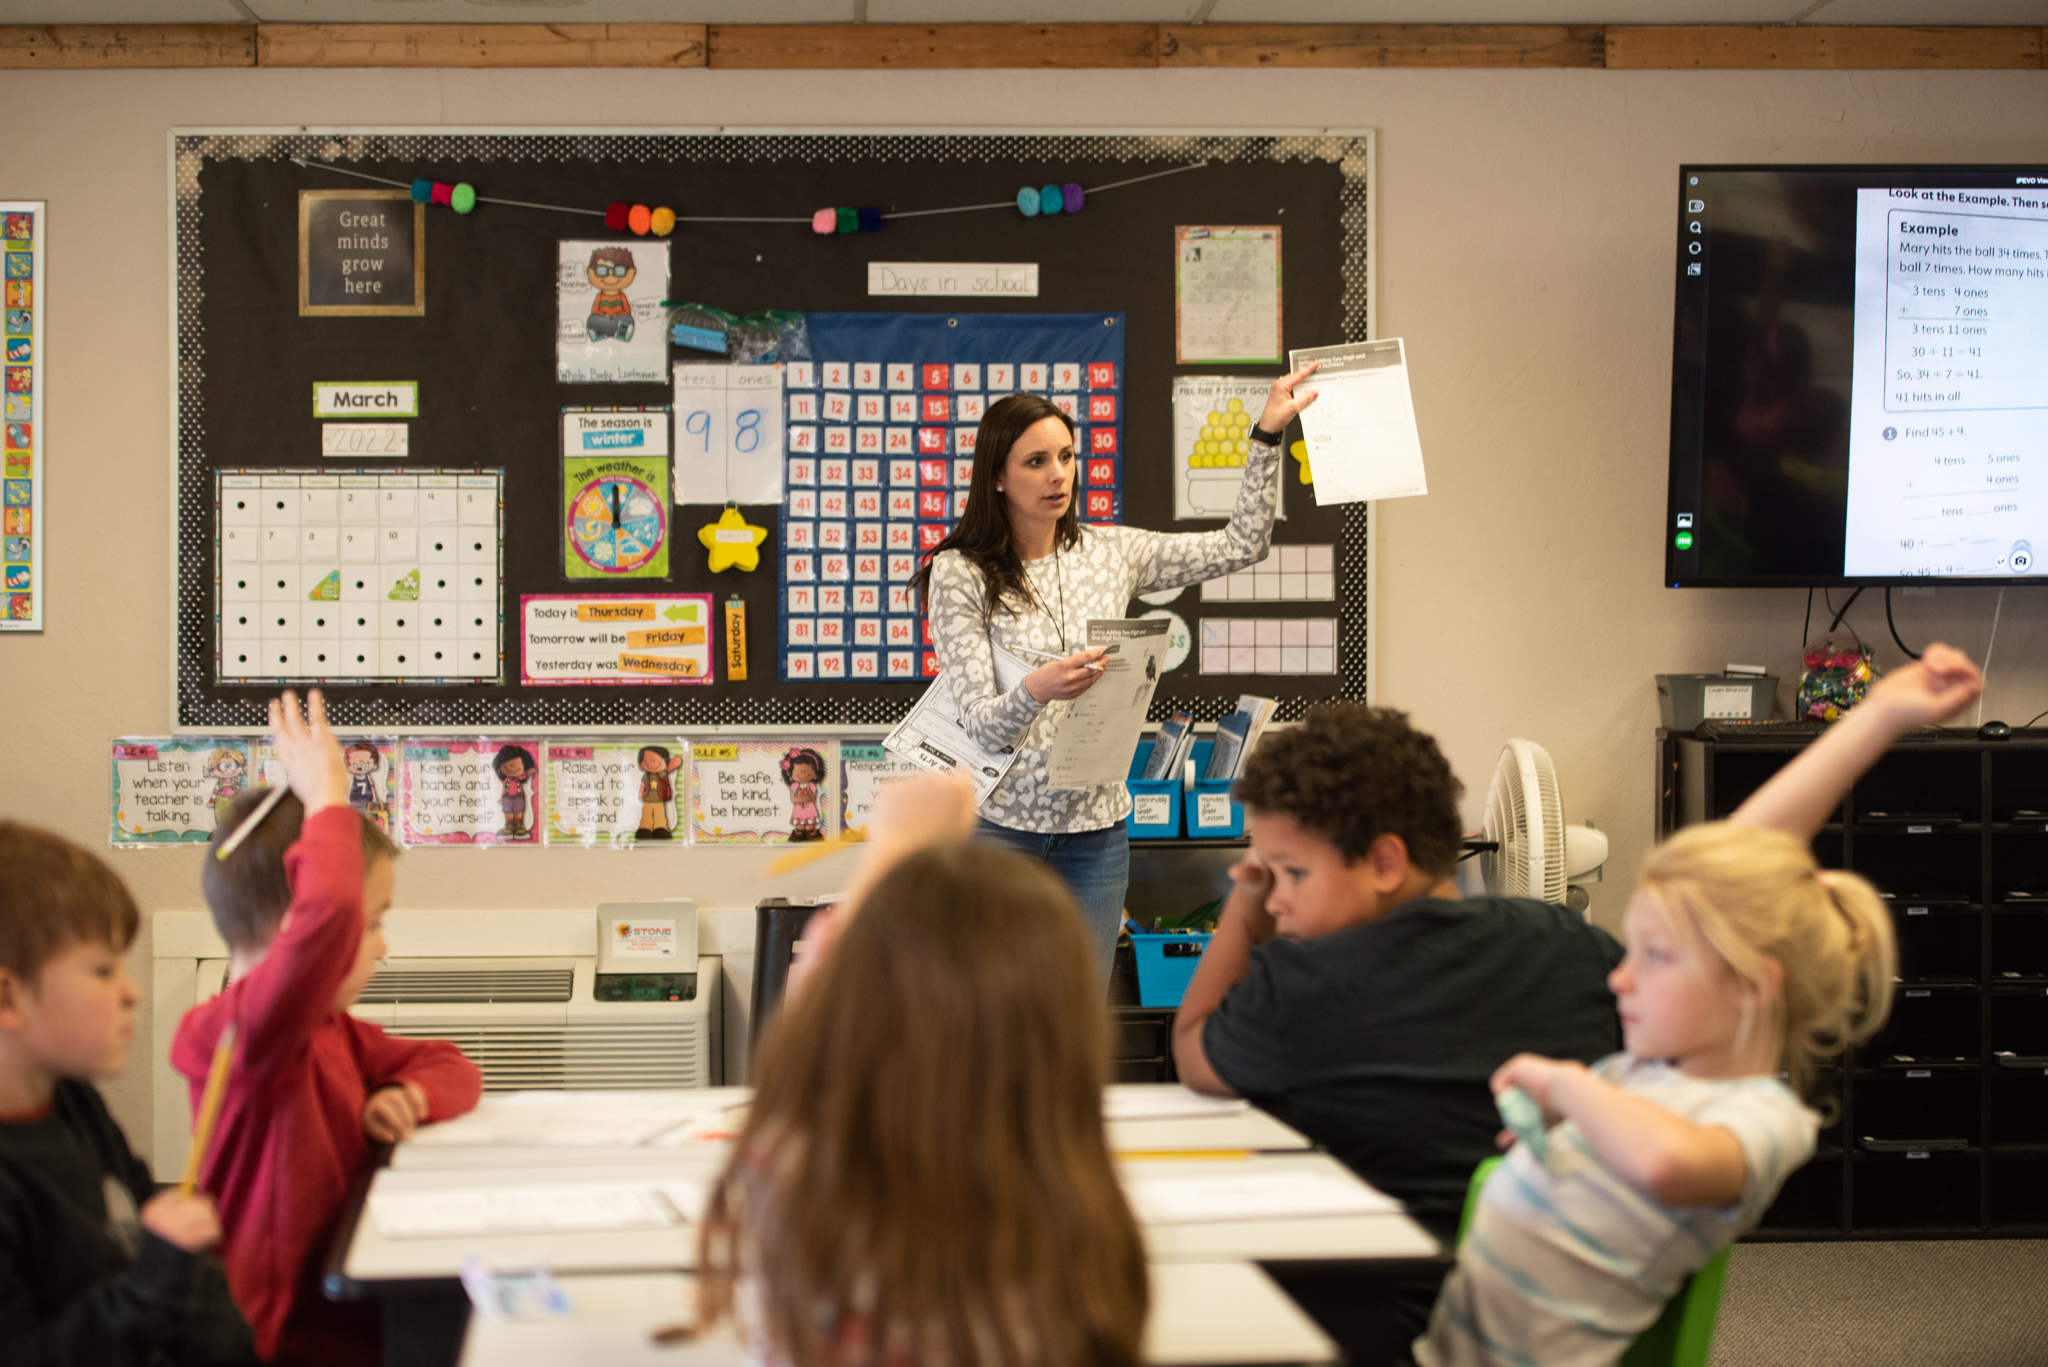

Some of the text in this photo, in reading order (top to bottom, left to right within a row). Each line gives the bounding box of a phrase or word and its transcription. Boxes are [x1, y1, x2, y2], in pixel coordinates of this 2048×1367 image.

[1889, 188, 2038, 208] Look at the Example. Then
[340, 211, 385, 227] Great
[1900, 222, 1958, 238] Example
[338, 233, 388, 249] minds
[1900, 242, 2042, 260] Mary hits the ball 34 times.
[342, 259, 383, 275] grow
[1900, 261, 2044, 280] ball 7 times. How many hits
[345, 277, 381, 293] here
[881, 267, 1029, 295] Days in school
[1912, 285, 1989, 298] 3 tens 4 ones
[1954, 306, 1988, 316] 7 ones
[1912, 324, 1988, 335] 3 tens 11 ones
[1912, 347, 1982, 358] 30 11 41
[682, 374, 772, 386] tens ones
[798, 369, 1109, 385] 1 2 3 4 5 6 7 8 9 10
[1897, 369, 1982, 381] So, 34 7 41.
[333, 391, 398, 408] March
[1896, 390, 1962, 402] 41 hits in all.
[798, 400, 1111, 416] 11 12 13 14 15 20
[578, 417, 652, 428] The season is
[686, 409, 761, 453] 9 8
[1906, 428, 1929, 438] Find
[1932, 427, 1944, 437] 45
[334, 428, 397, 453] 2022
[591, 432, 635, 446] winter
[797, 432, 1112, 448] 21 22 23 24 30
[1934, 454, 2020, 466] 4 tens 5 ones
[574, 461, 656, 484] The weather is
[795, 465, 1110, 481] 31 32 33 34 40
[347, 494, 353, 502] 2
[386, 493, 392, 501] 3
[428, 492, 434, 500] 4
[796, 497, 1108, 512] 41 42 43 44 45 50
[228, 532, 235, 540] 6
[268, 532, 274, 540] 7
[308, 532, 314, 540] 8
[388, 531, 398, 540] 10
[534, 606, 644, 620] Today is Thursday
[530, 630, 685, 644] Tomorrow will be Friday
[732, 614, 742, 668] Saturday
[535, 657, 692, 674] Yesterday was Wednesday
[548, 748, 586, 757] RULE #4
[693, 748, 730, 757] RULE #5
[842, 749, 879, 758] RULE #6
[147, 760, 190, 772] Listen
[850, 760, 896, 774] Respect
[919, 752, 938, 768] Arts
[420, 762, 490, 777] Keep your
[562, 762, 634, 776] Raise your
[132, 776, 205, 792] when your
[420, 778, 490, 790] hands and
[718, 770, 774, 786] Be safe,
[356, 782, 366, 795] 7
[720, 788, 771, 802] be kind,
[134, 793, 204, 806] teacher is
[146, 809, 192, 824] talking.
[710, 804, 781, 818] be honest.
[634, 928, 672, 936] STONE
